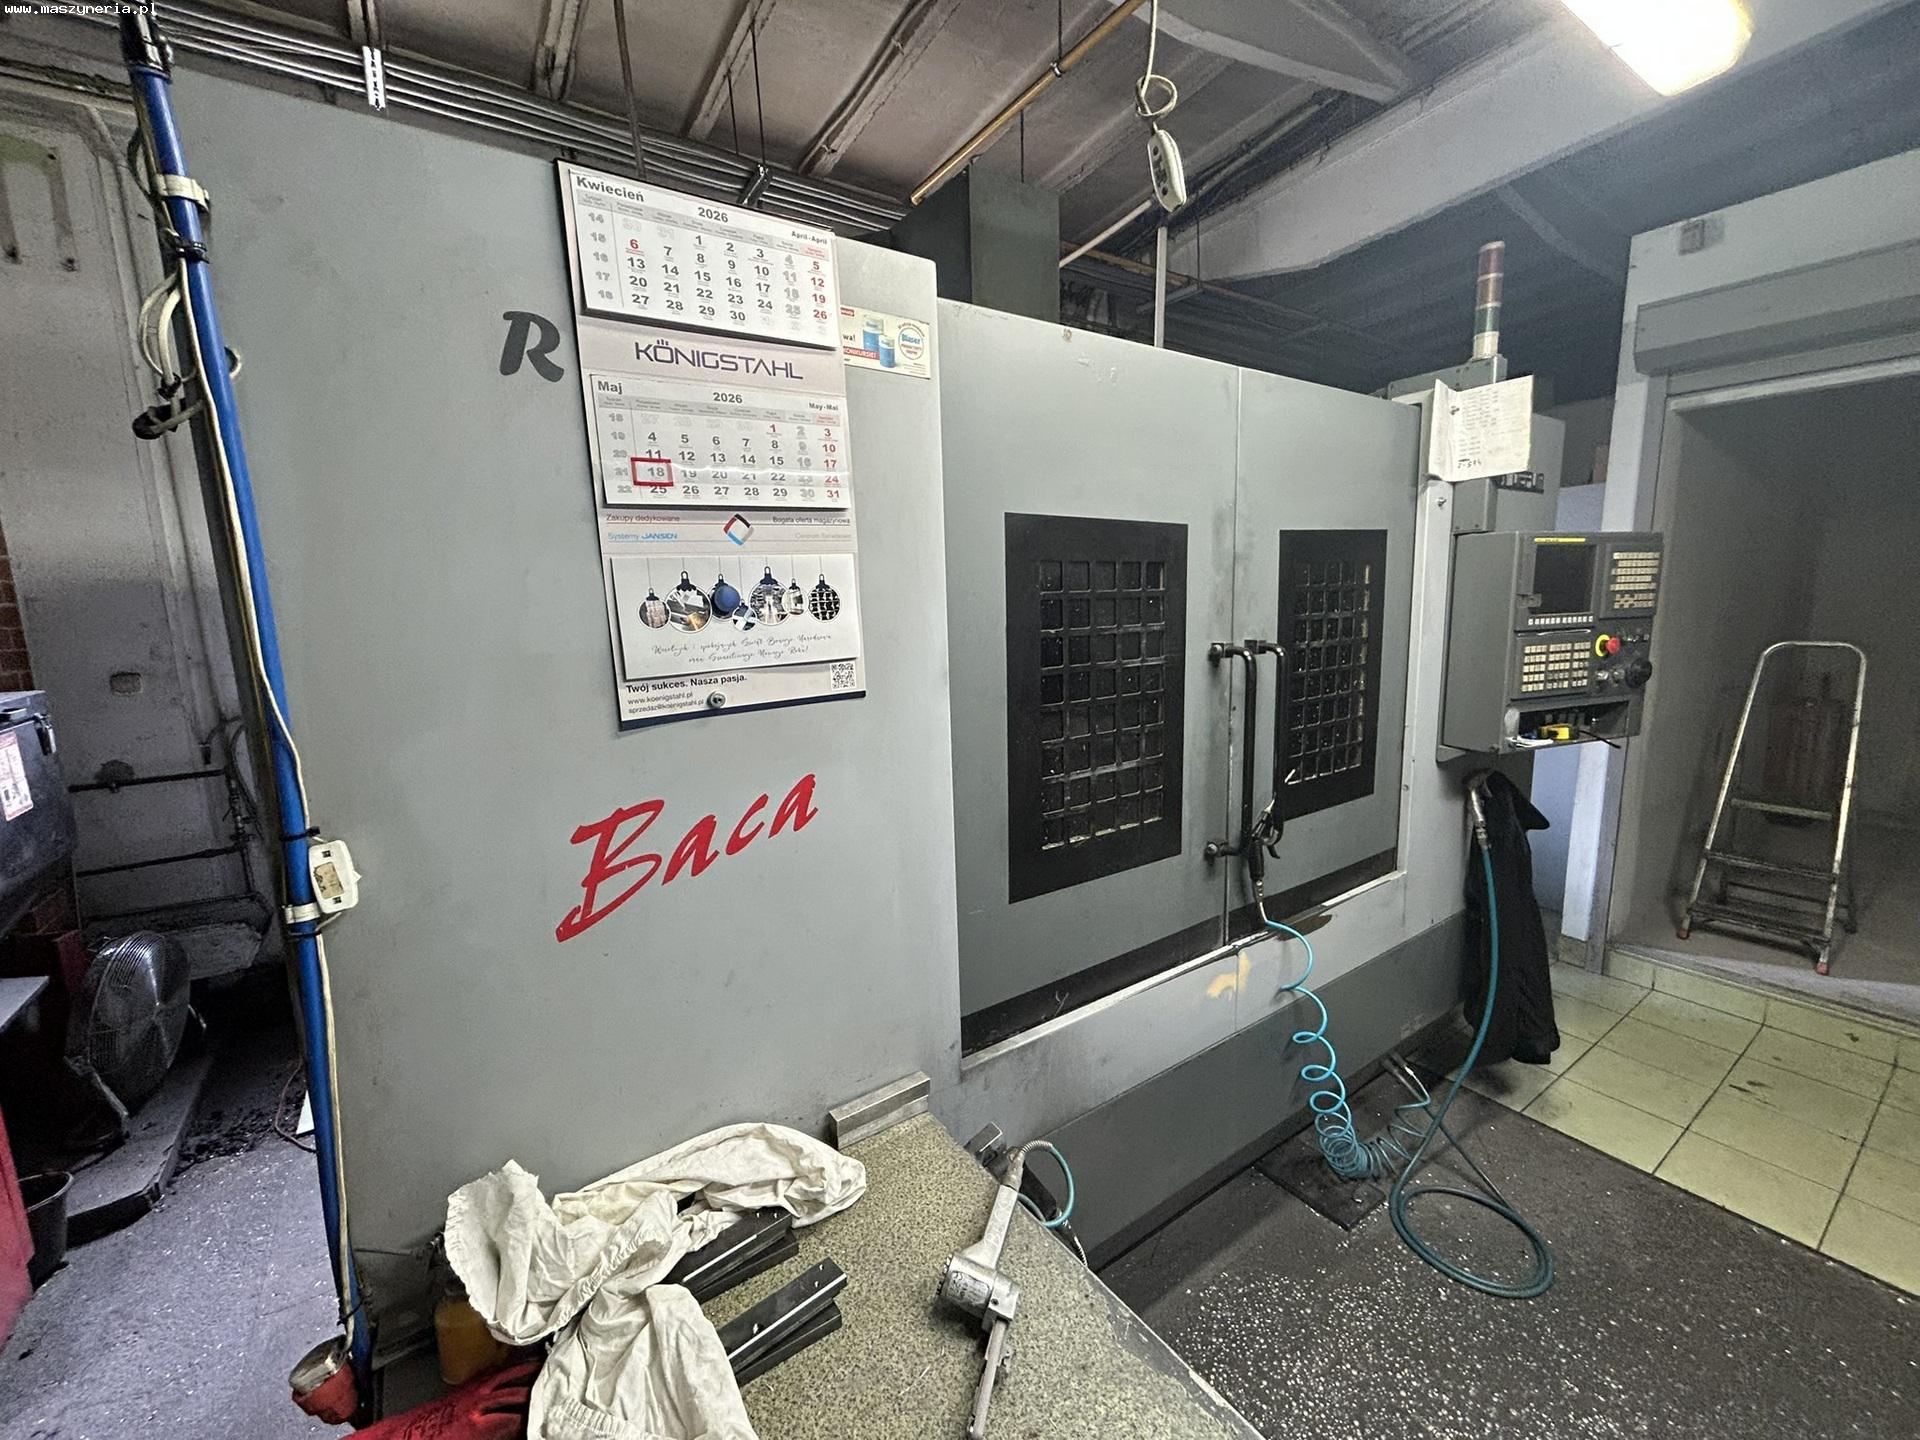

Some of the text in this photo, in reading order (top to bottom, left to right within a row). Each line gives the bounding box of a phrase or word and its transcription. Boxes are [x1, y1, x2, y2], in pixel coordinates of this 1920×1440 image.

[576, 176, 644, 202] Kwiecień
[697, 207, 729, 223] 2026
[695, 235, 702, 245] 1
[726, 242, 735, 252] 2
[756, 248, 764, 258] 3
[813, 261, 820, 270] 5
[629, 239, 639, 249] 6
[664, 246, 672, 256] 7
[697, 253, 705, 263] 8
[728, 260, 736, 269] 9
[754, 265, 769, 276] 10
[811, 277, 824, 287] 12
[627, 257, 646, 269] 13
[661, 264, 679, 275] 14
[694, 271, 711, 281] 15
[726, 277, 741, 288] 16
[756, 283, 770, 293] 17
[812, 293, 826, 304] 19
[629, 276, 647, 287] 20
[663, 282, 680, 293] 21
[696, 288, 713, 299] 22
[727, 293, 744, 304] 23
[757, 299, 773, 310] 24
[813, 309, 827, 320] 26
[631, 294, 649, 305] 27
[666, 299, 683, 311] 28
[698, 305, 715, 316] 29
[729, 310, 745, 321] 30
[500, 311, 564, 382] R
[634, 339, 803, 380] KÖNIGSTAHL
[597, 380, 623, 395] Maj
[713, 392, 743, 404] 2026
[809, 403, 823, 411] May
[769, 424, 776, 433] 1
[824, 428, 831, 437] 3
[647, 432, 657, 441] 4
[681, 434, 689, 443] 5
[712, 436, 720, 445] 6
[742, 438, 750, 447] 7
[771, 440, 779, 449] 8
[822, 444, 836, 453] 10
[645, 449, 661, 458] 11
[679, 451, 696, 461] 12
[710, 453, 726, 462] 13
[740, 455, 756, 464] 14
[769, 456, 784, 466] 15
[824, 459, 837, 468] 17
[647, 467, 665, 477] 18
[681, 469, 697, 478] 19
[712, 470, 728, 479] 20
[771, 472, 786, 481] 22
[825, 475, 839, 483] 24
[650, 485, 667, 494] 25
[682, 485, 700, 495] 26
[713, 486, 730, 495] 27
[744, 487, 760, 496] 28
[772, 488, 788, 497] 29
[800, 489, 815, 498] 30
[826, 490, 840, 498] 31
[606, 514, 680, 523] Zakupy dedykowane
[608, 532, 639, 541] Systemy
[626, 674, 747, 693] Twój sukces. Nasza pasja.
[627, 691, 693, 705] www.koenigstahl.pl
[556, 773, 818, 942] Baca
